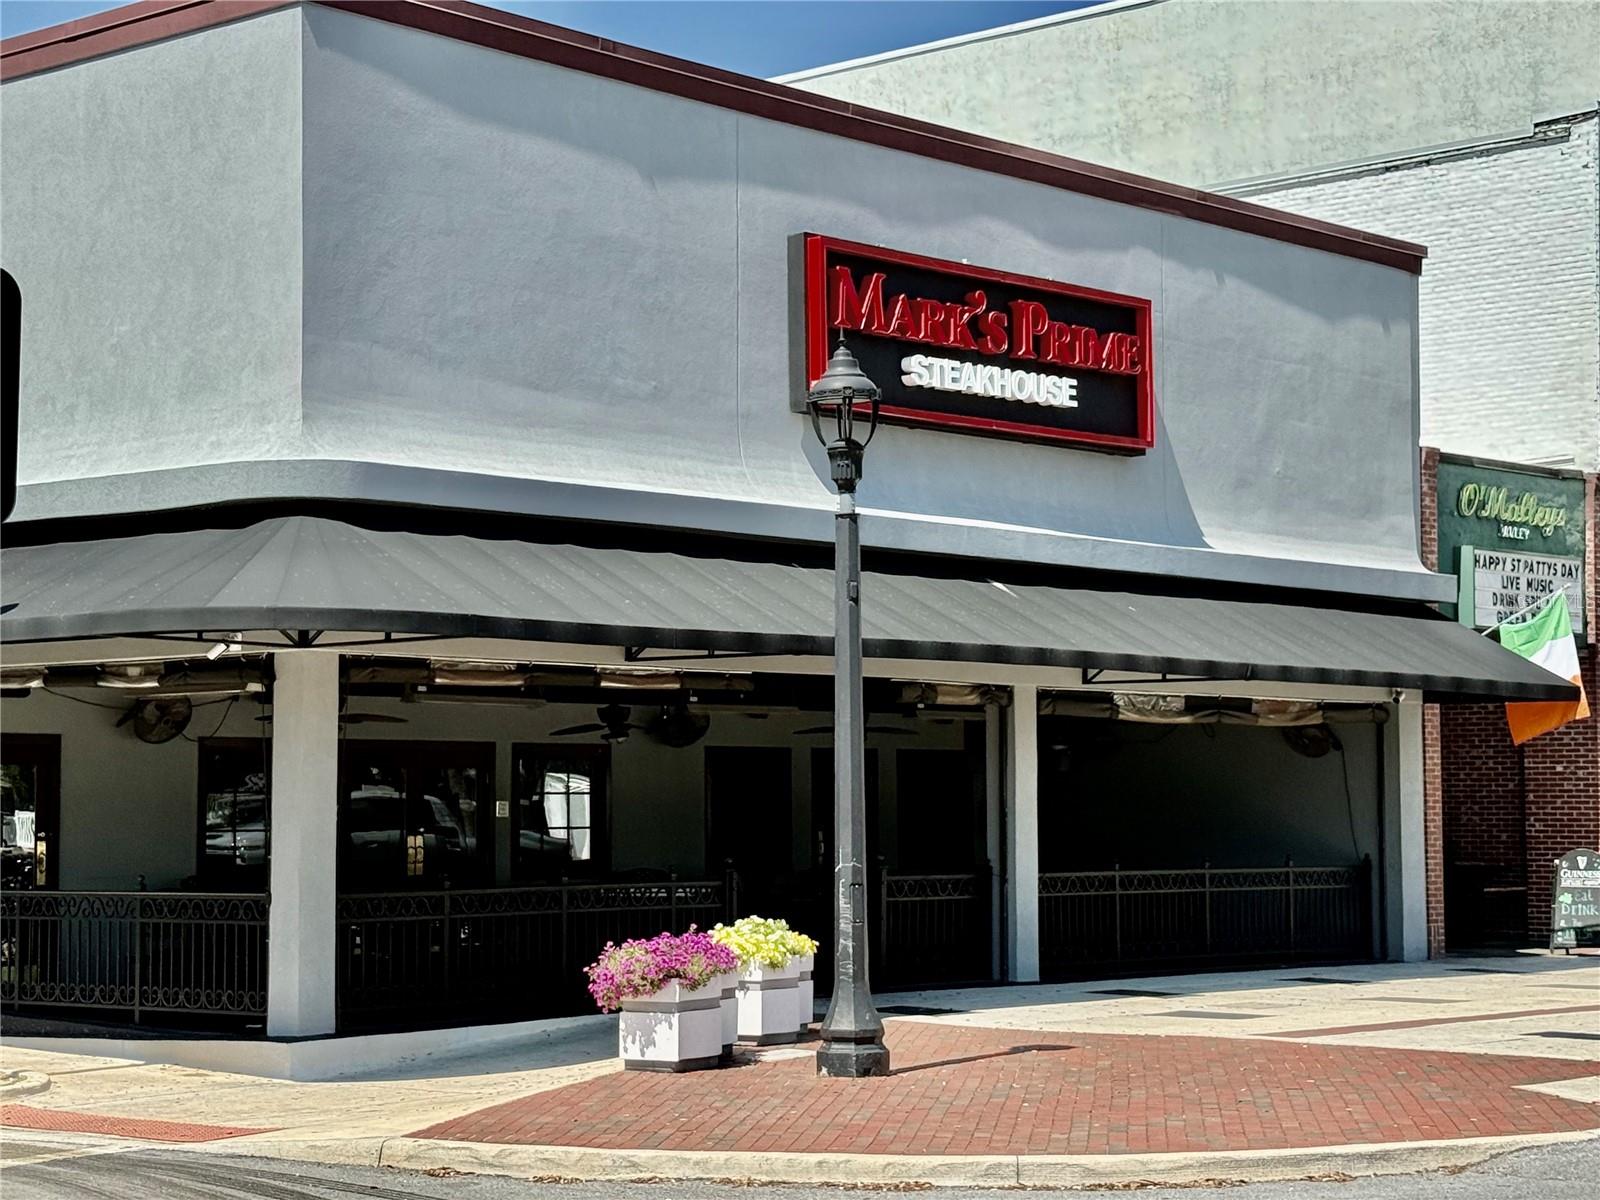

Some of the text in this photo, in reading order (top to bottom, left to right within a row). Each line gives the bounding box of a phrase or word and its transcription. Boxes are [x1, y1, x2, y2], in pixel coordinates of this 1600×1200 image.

[829, 265, 1143, 375] MARK'S PRIME
[901, 354, 1079, 408] STEAKHOUSE
[1474, 553, 1580, 579] HAPPY ST PATTYS DAY
[1501, 574, 1554, 594] LIVE MUSIC
[1492, 592, 1519, 608] DRINK
[1560, 868, 1600, 879] GUINNESS
